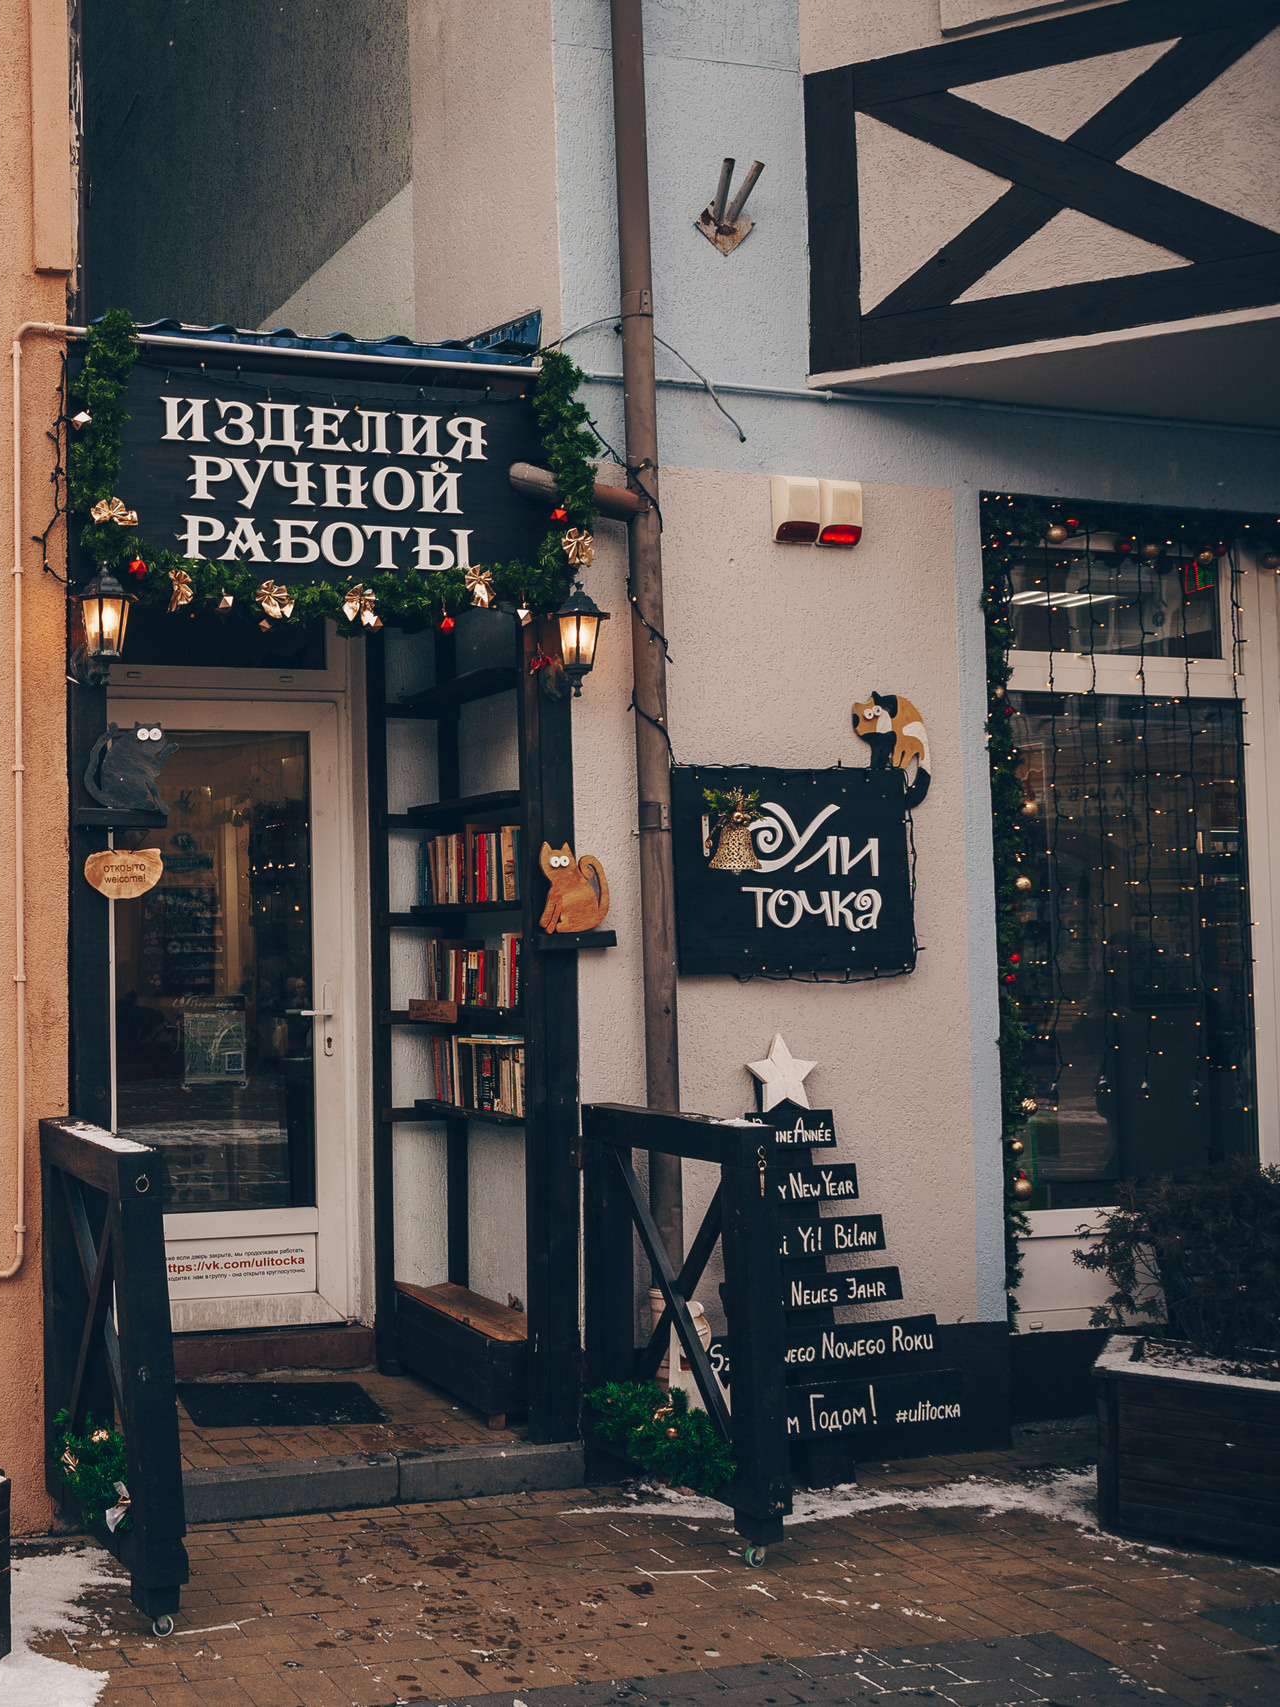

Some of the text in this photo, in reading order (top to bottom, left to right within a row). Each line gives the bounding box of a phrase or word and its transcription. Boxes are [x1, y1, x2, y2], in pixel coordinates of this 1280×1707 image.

[160, 396, 488, 463] ИЗДЕЛИЯ
[186, 454, 463, 515] РУЧНОЙ
[177, 514, 472, 571] РАБОТЫ
[104, 875, 146, 884] welcome!
